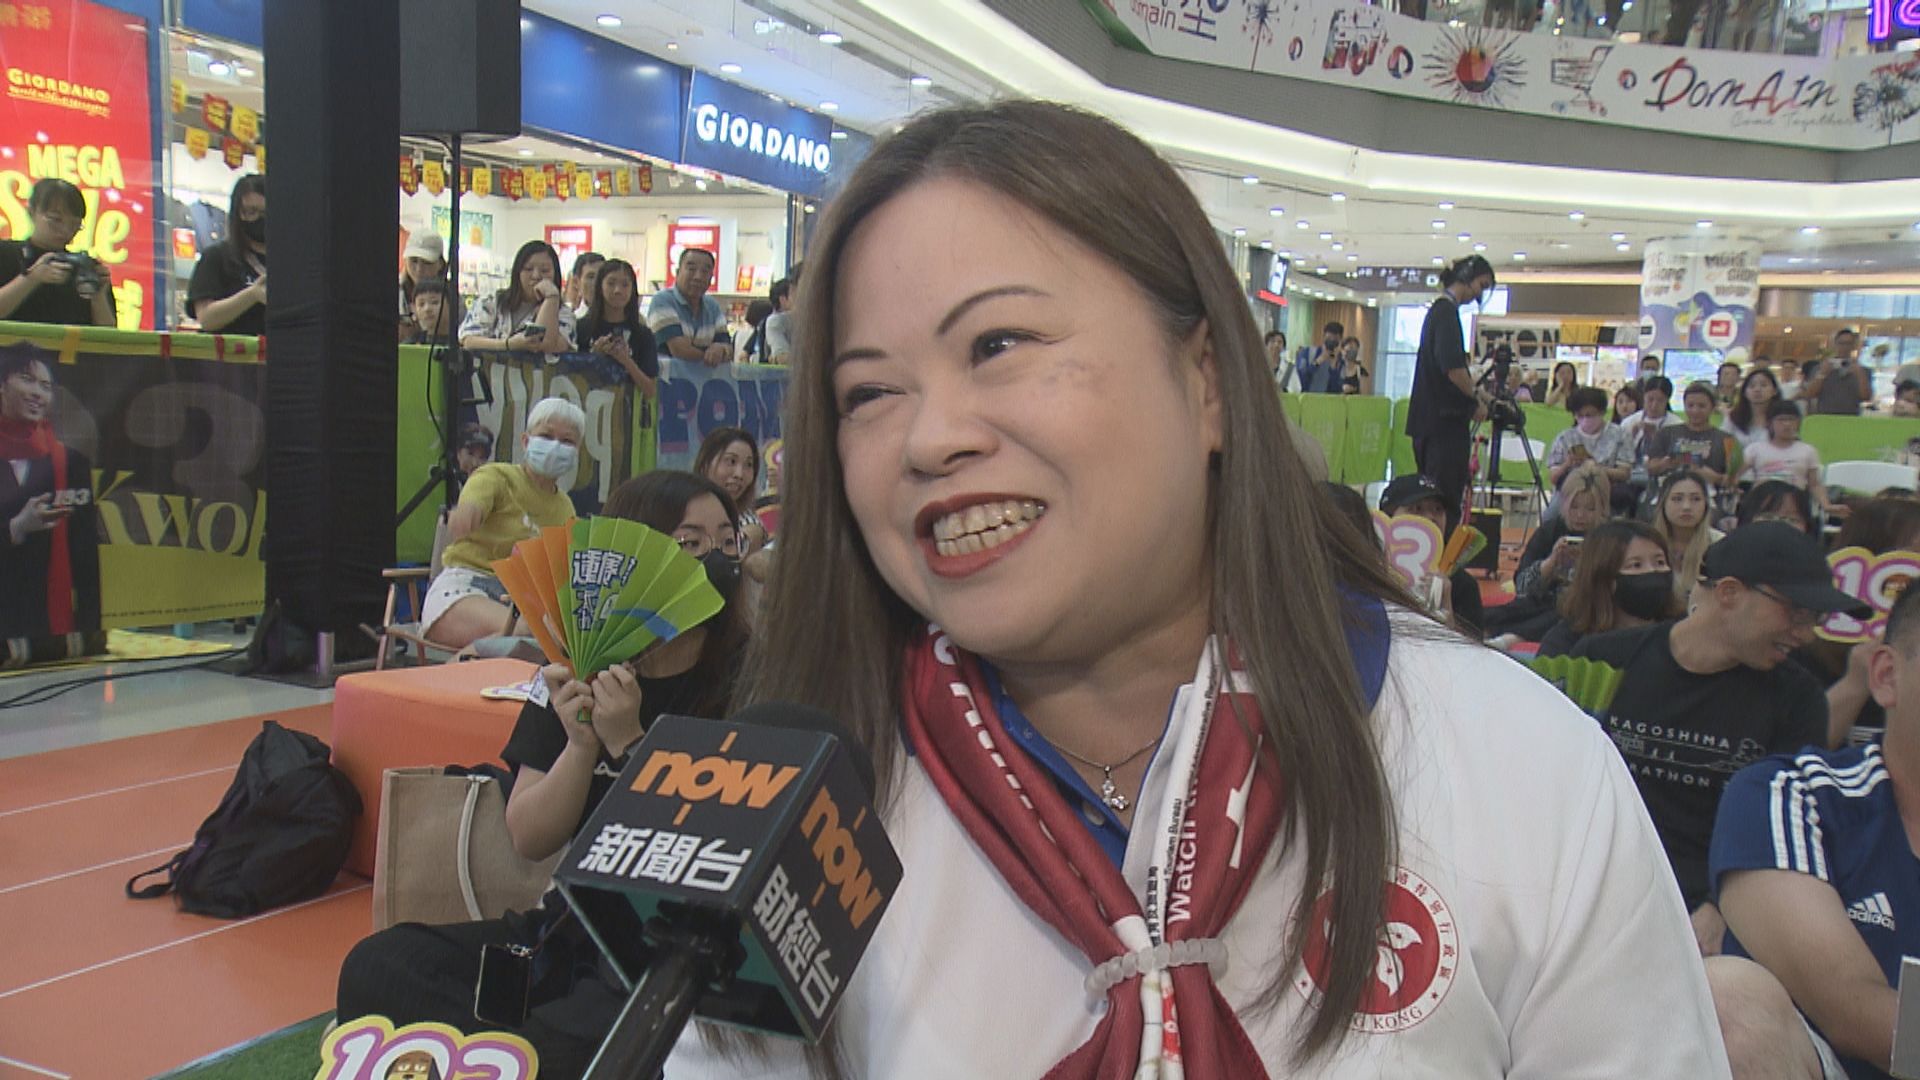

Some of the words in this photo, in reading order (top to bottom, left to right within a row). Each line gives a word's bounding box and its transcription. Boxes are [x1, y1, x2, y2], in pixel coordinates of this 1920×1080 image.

[7, 68, 110, 104] GIORDANO
[28, 144, 125, 189] MEGA
[696, 103, 830, 173] GIORDANO
[0, 170, 130, 264] Sle
[1609, 715, 1730, 750] KAGOSHIMA
[630, 749, 800, 809] now
[1629, 763, 1710, 787] RATHON
[577, 824, 752, 892] 新聞台
[800, 786, 883, 929] now
[1167, 820, 1197, 925] Watch
[753, 863, 839, 1020] 財經台
